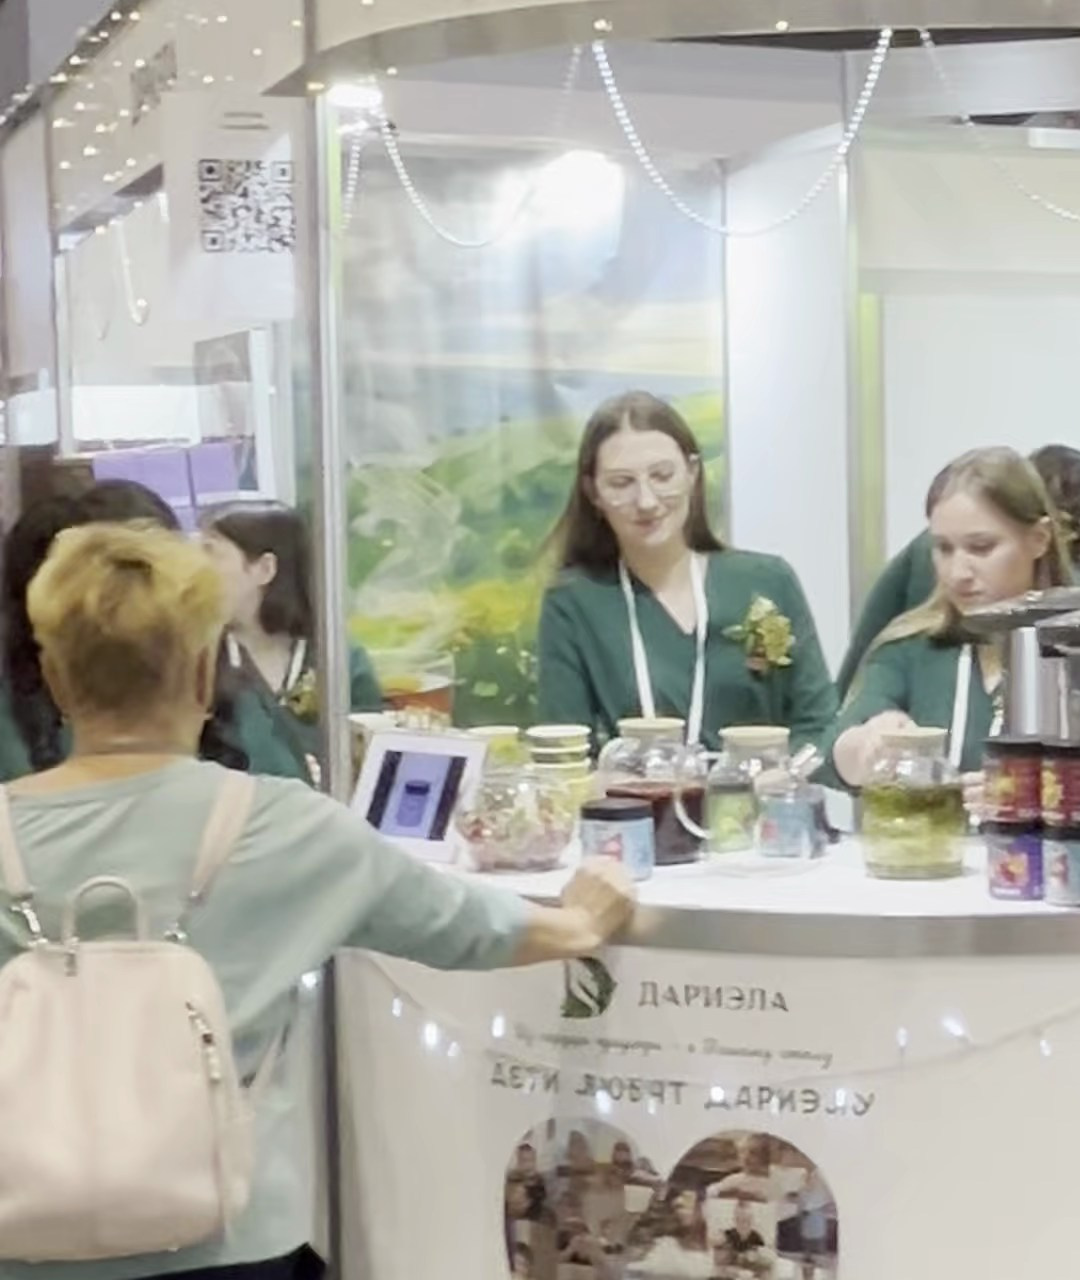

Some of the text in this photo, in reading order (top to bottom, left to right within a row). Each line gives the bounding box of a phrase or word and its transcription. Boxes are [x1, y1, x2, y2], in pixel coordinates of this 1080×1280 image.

[637, 980, 790, 1013] ДАРИЭЛА
[491, 1062, 560, 1095] ДЕТИ
[575, 1073, 688, 1106] ЛЮБЯТ
